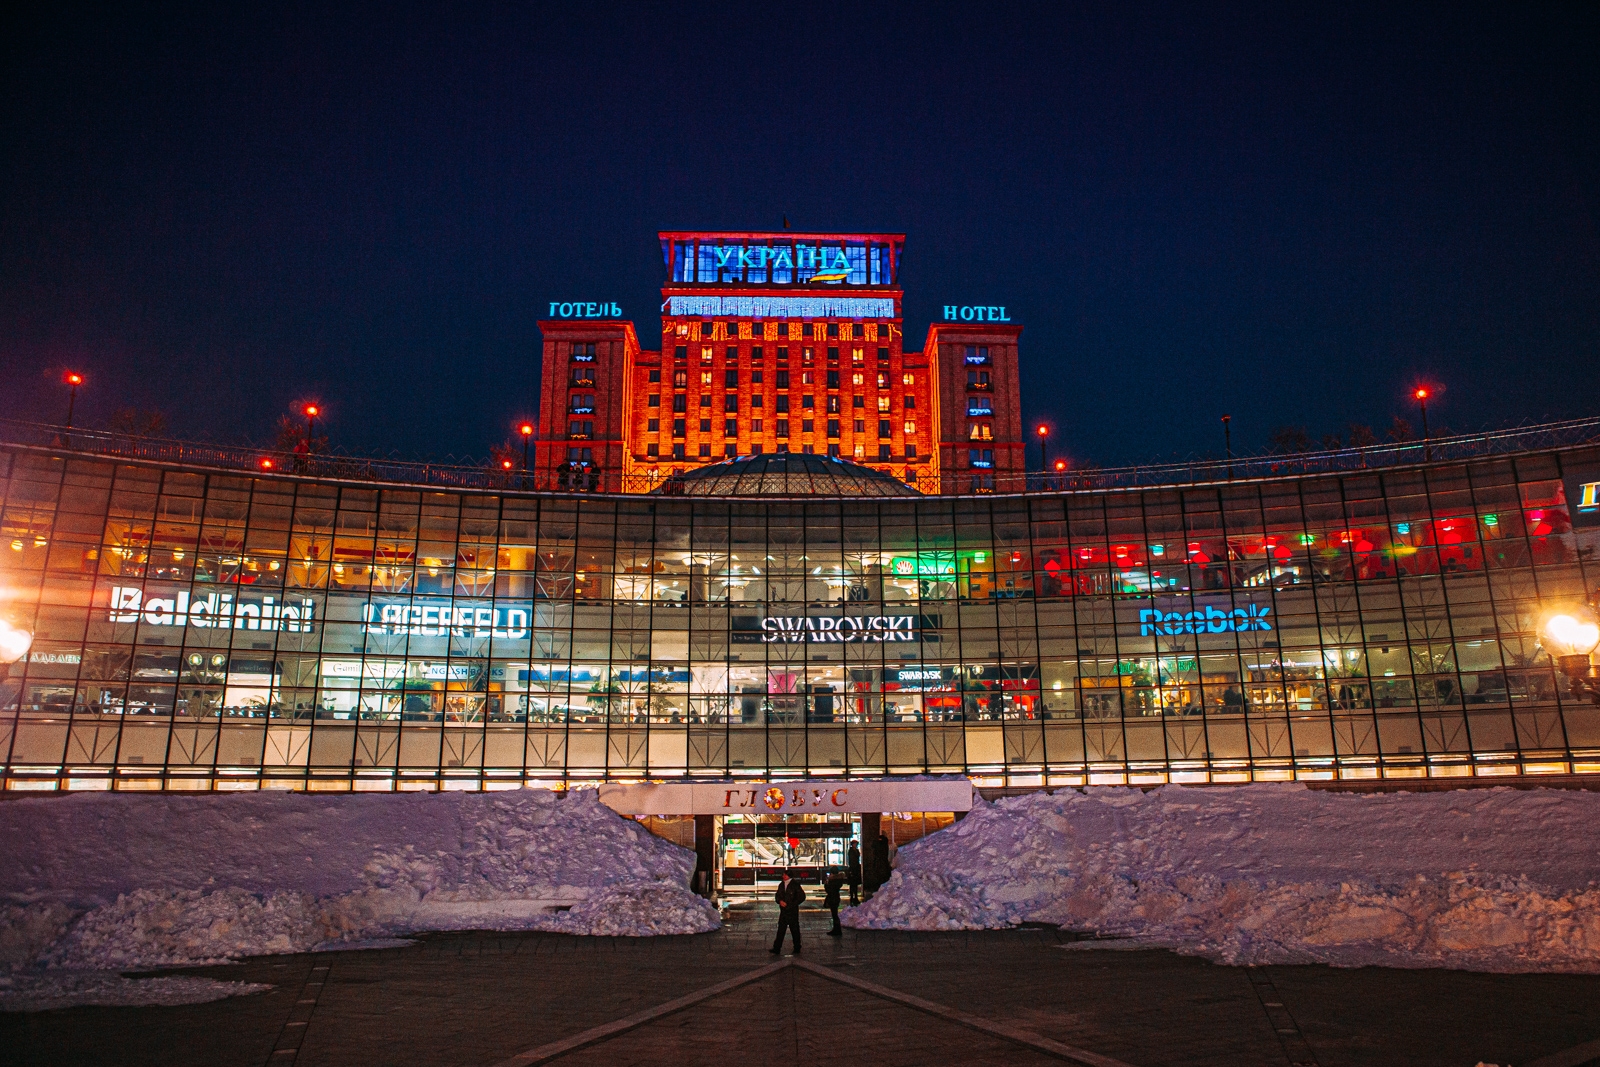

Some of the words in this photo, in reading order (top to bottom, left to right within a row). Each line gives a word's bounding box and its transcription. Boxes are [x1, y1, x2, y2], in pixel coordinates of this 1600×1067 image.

[715, 243, 852, 270] УКРАЇНА
[549, 301, 622, 319] ГОТЕЛЬ
[943, 304, 1011, 322] HOTEL
[109, 586, 313, 633] Baldinini
[362, 603, 527, 639] LAGERFELD
[1139, 603, 1272, 637] Reebok
[761, 616, 914, 642] SWAROVSKI
[333, 663, 366, 673] Gamil
[722, 786, 848, 811] ГЛОБУС
